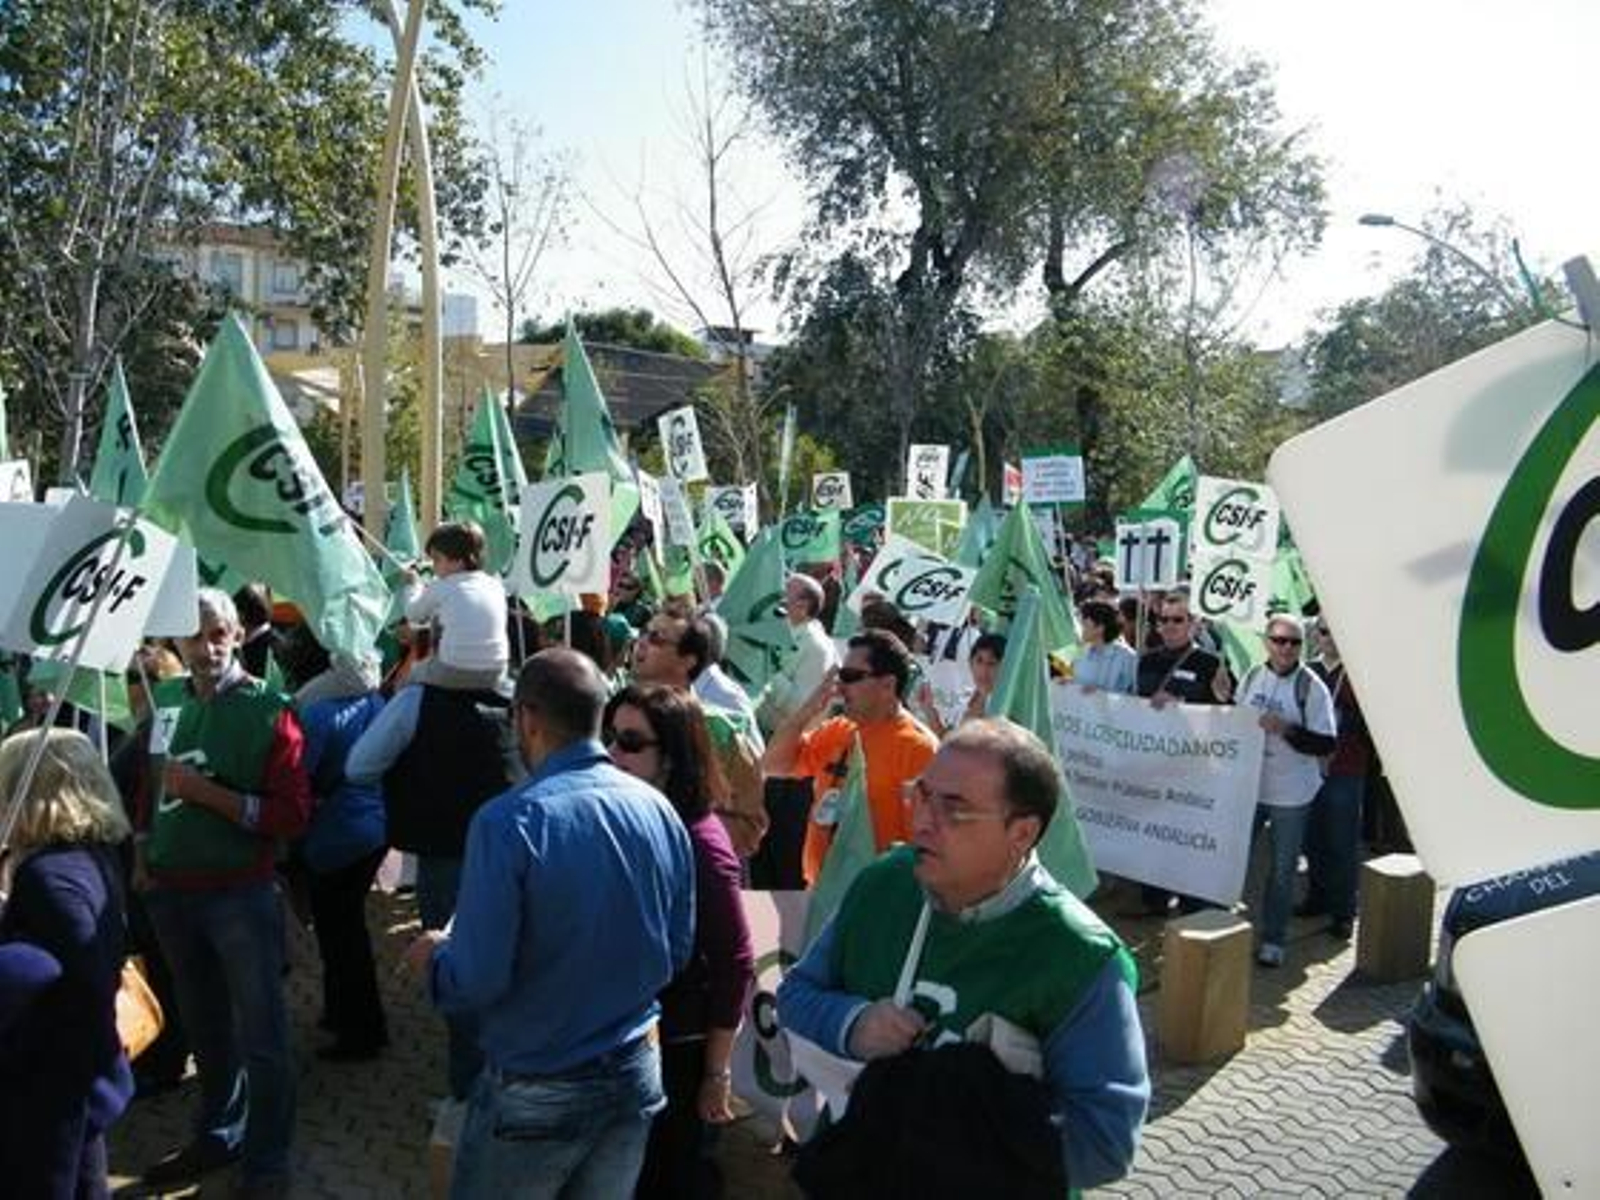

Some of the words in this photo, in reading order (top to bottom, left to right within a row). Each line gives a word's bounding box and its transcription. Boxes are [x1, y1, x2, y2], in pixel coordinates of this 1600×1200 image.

[1215, 503, 1269, 530] CSI-F
[541, 513, 595, 553] CSI-F
[910, 577, 966, 601] CSI-F
[1209, 573, 1258, 601] CSI-F
